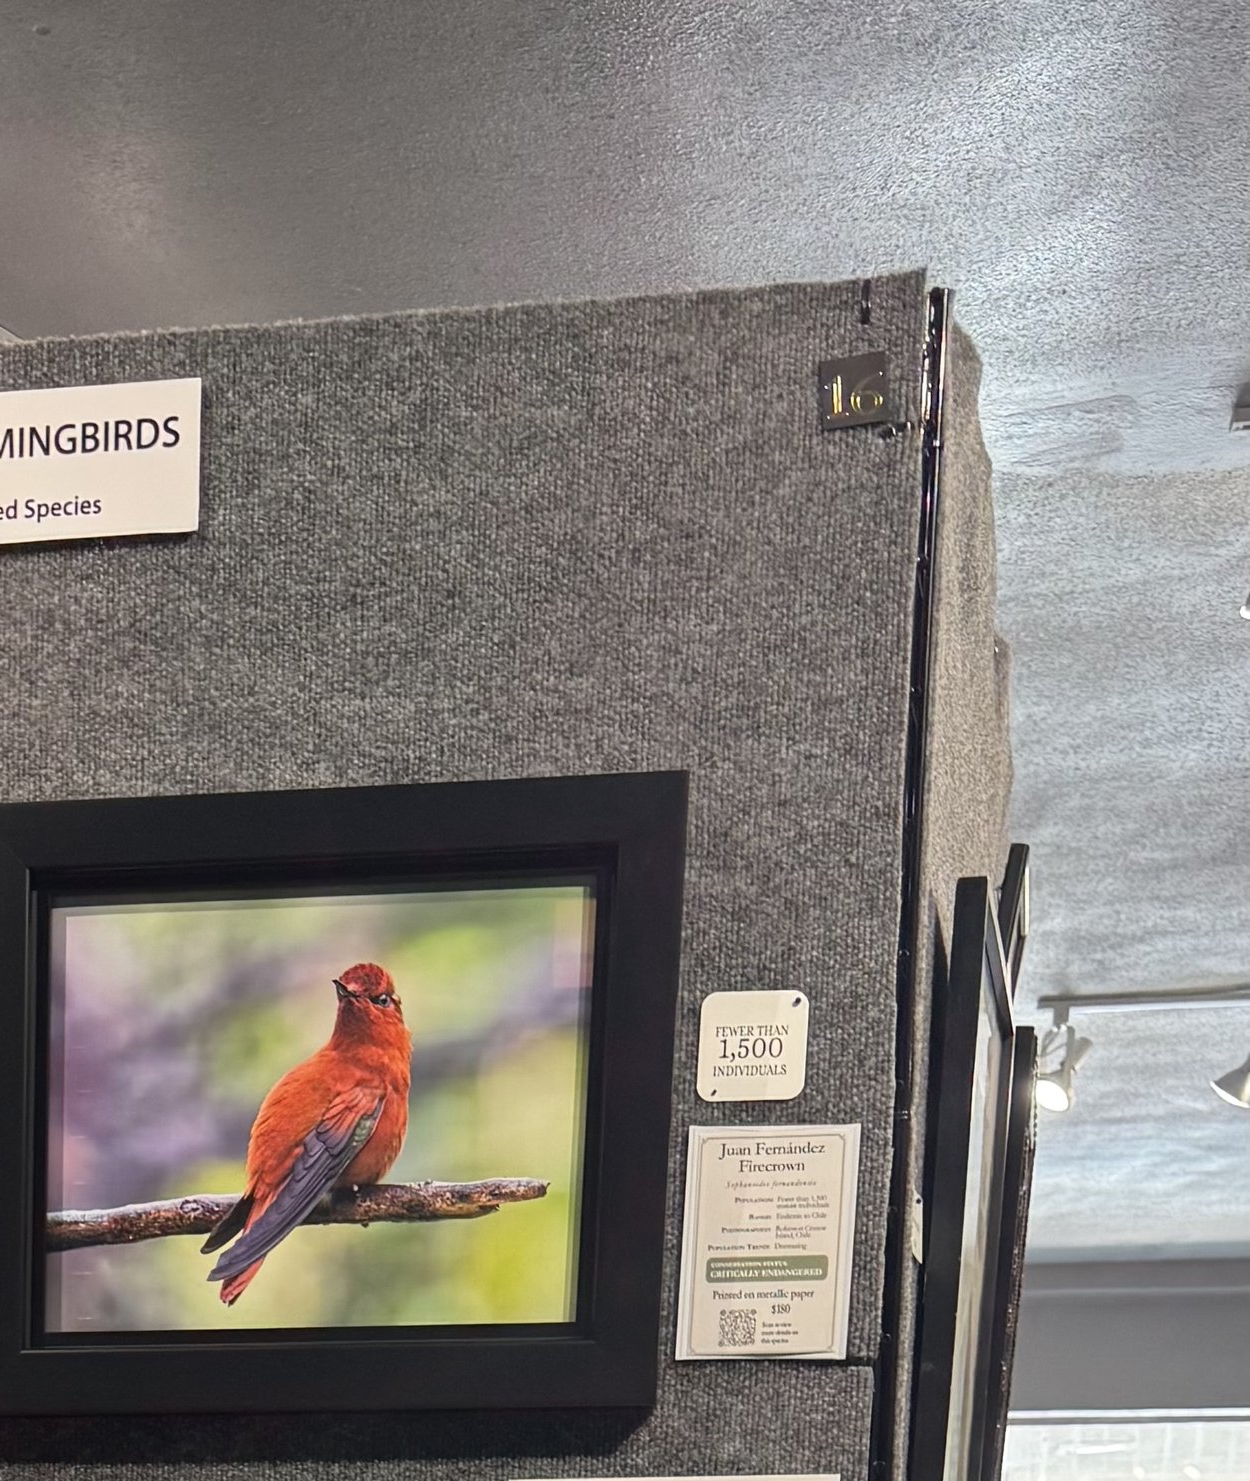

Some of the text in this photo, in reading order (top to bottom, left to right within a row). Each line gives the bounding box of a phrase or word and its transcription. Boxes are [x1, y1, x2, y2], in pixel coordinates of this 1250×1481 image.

[24, 495, 101, 523] Species
[715, 1024, 788, 1038] FEWER THAN
[719, 1037, 782, 1061] 1,500
[713, 1063, 786, 1077] INDIVIDUALS
[718, 1141, 825, 1160] Juan Fernández
[738, 1159, 804, 1172] Firecrown
[712, 1288, 814, 1301] Printed on metallic paper
